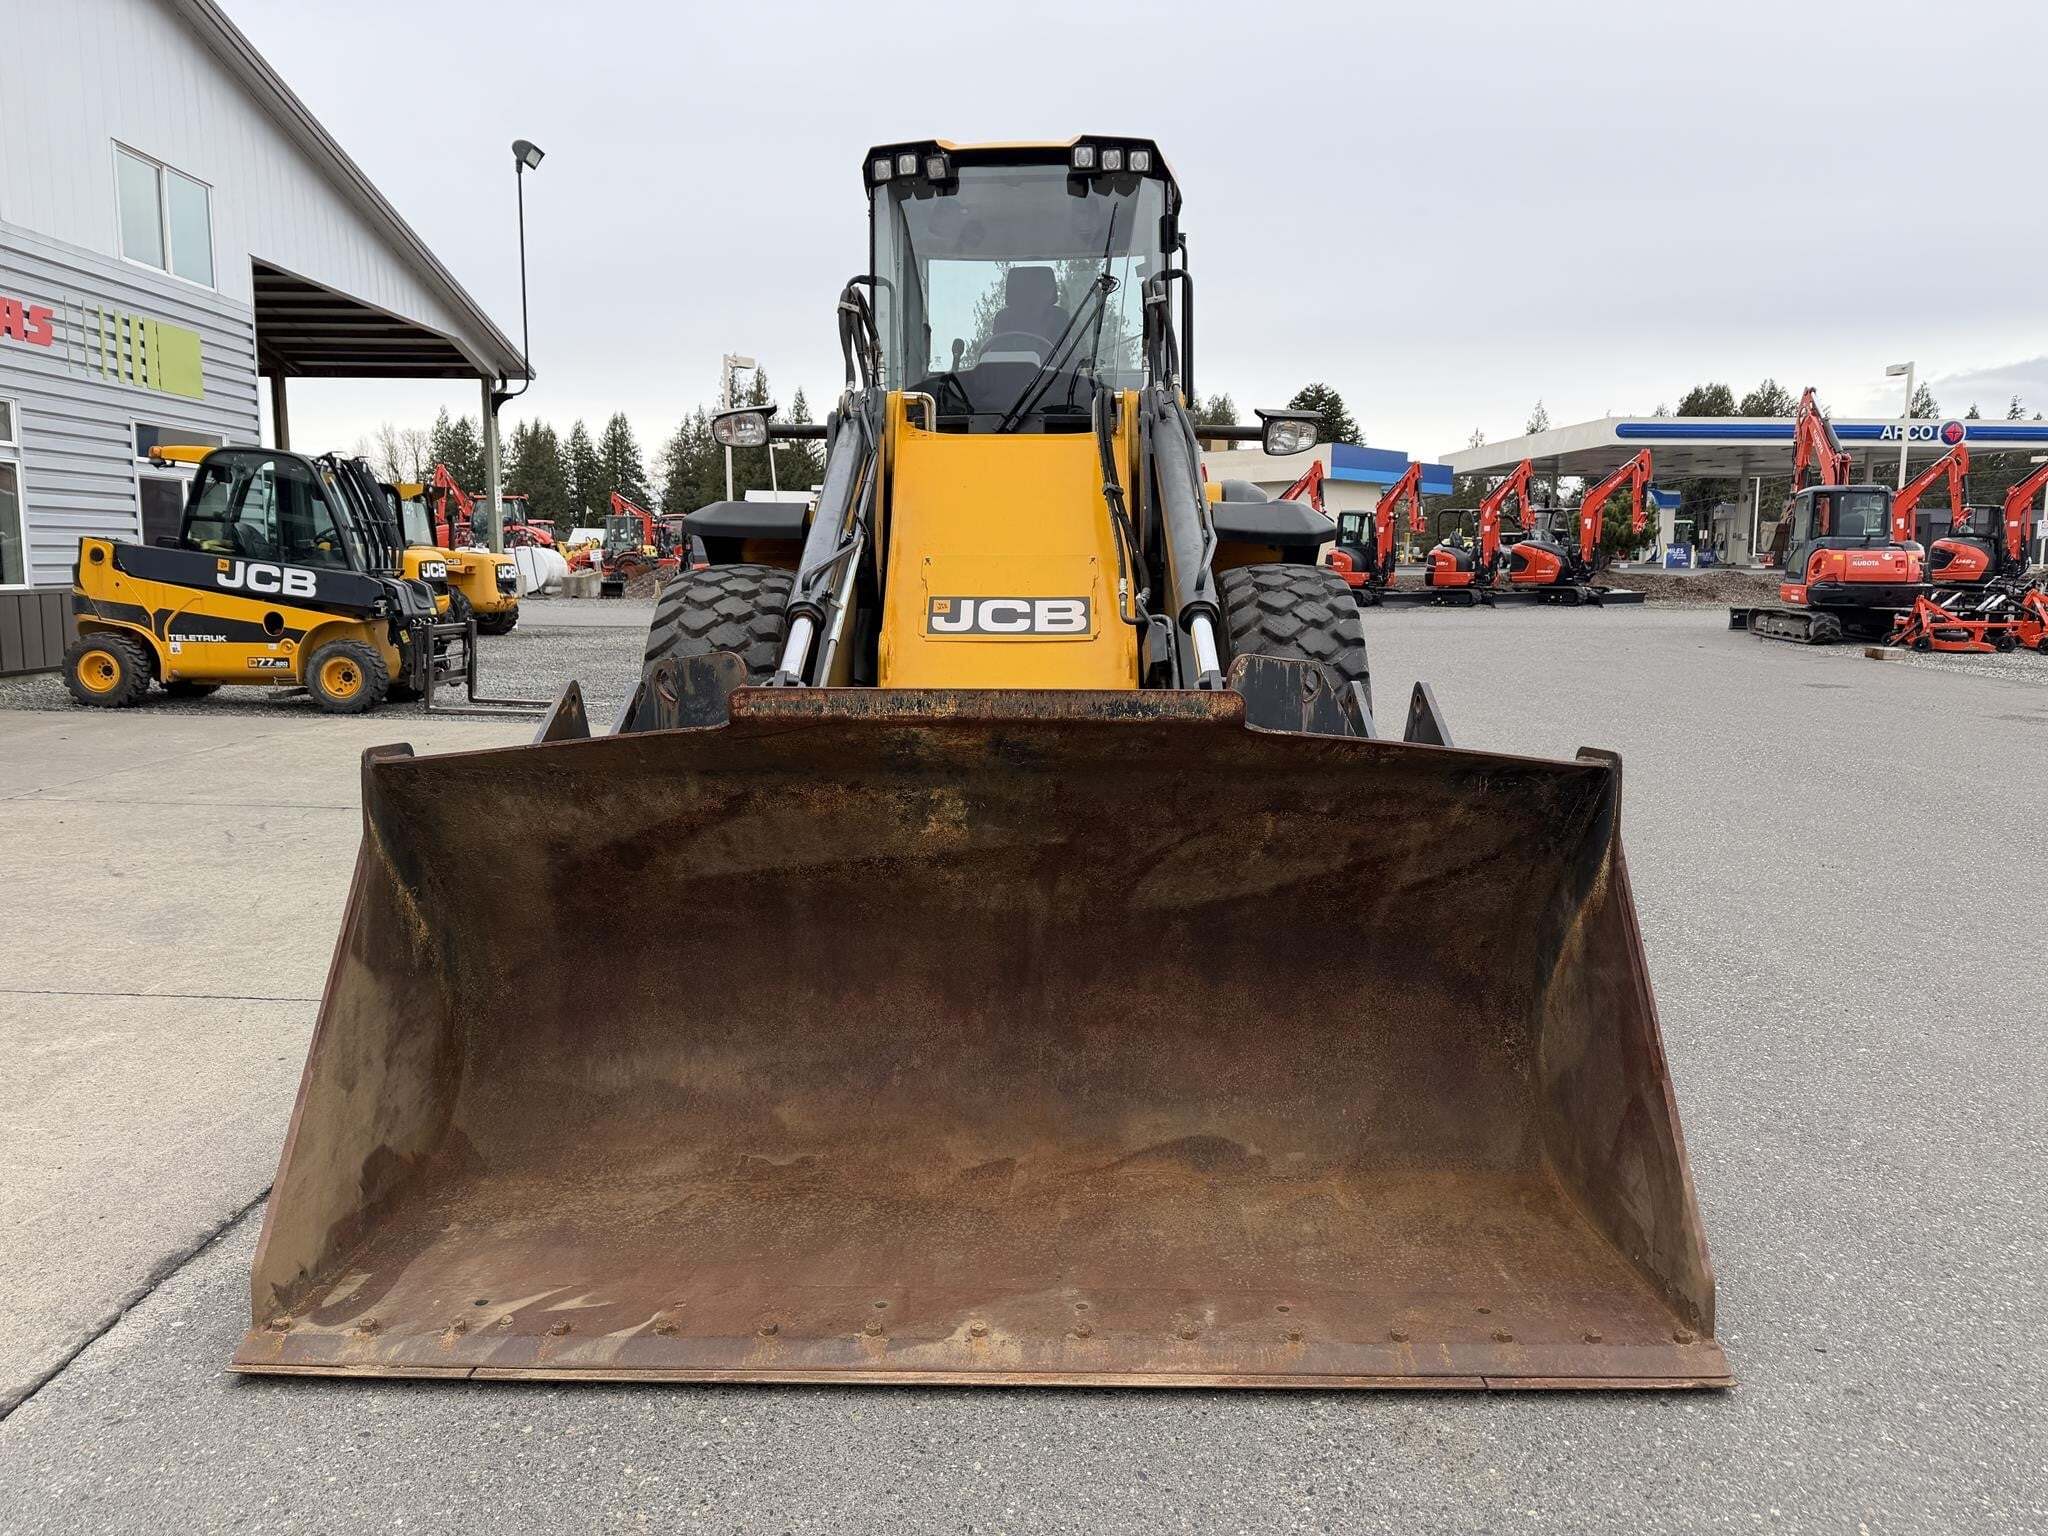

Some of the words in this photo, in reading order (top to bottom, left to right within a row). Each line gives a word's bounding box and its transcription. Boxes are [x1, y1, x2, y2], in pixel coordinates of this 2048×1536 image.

[422, 562, 447, 578] JCB
[497, 565, 516, 579] JCB
[217, 561, 317, 598] JCB
[932, 599, 1087, 632] JCB
[168, 634, 227, 643] TELETRUK
